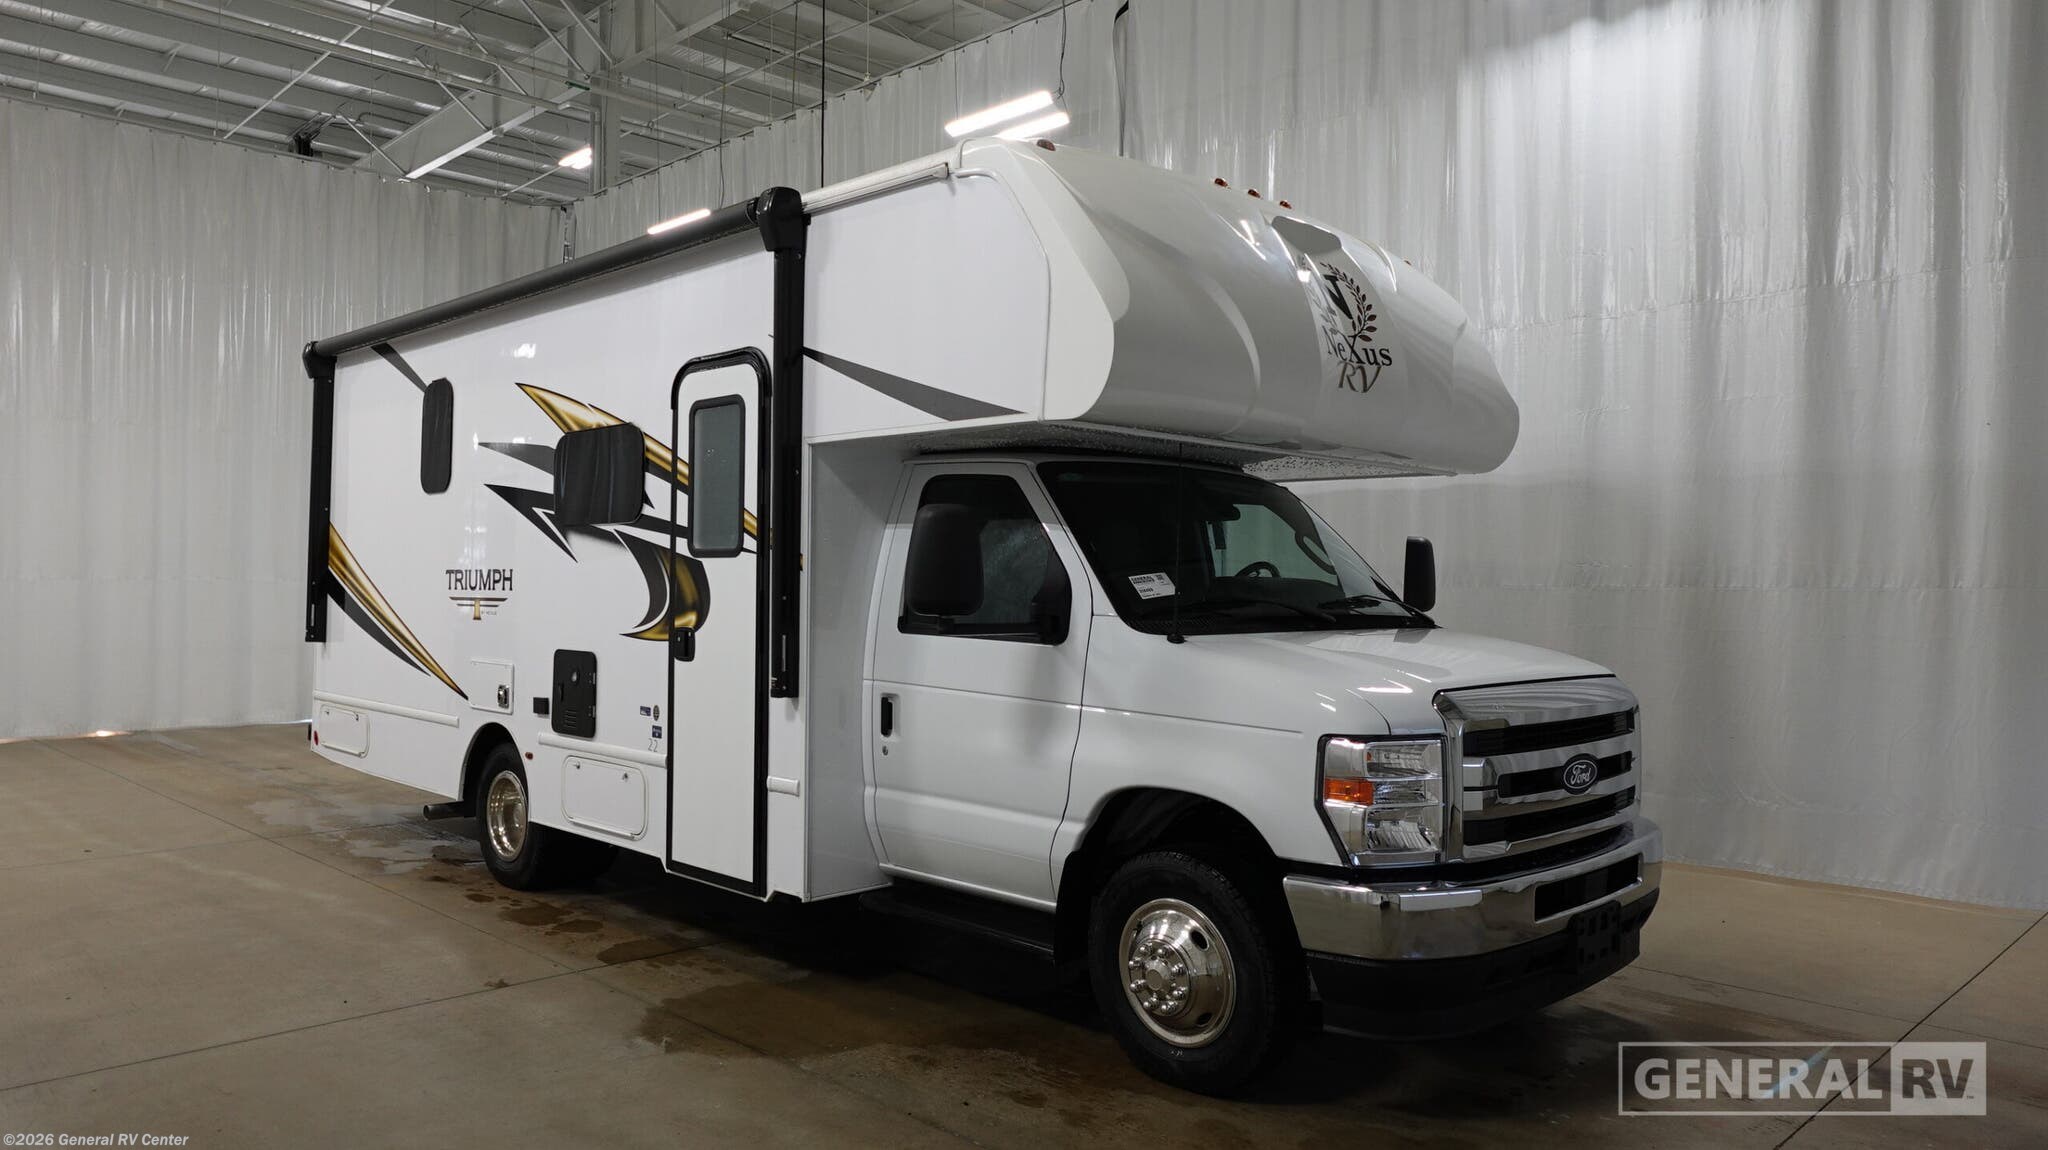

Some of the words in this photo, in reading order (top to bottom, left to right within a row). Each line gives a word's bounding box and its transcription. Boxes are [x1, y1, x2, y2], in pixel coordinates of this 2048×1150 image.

[1337, 361, 1382, 393] RV
[445, 568, 513, 591] TRIUMPH
[647, 737, 658, 753] 22
[1570, 764, 1592, 785] Ford
